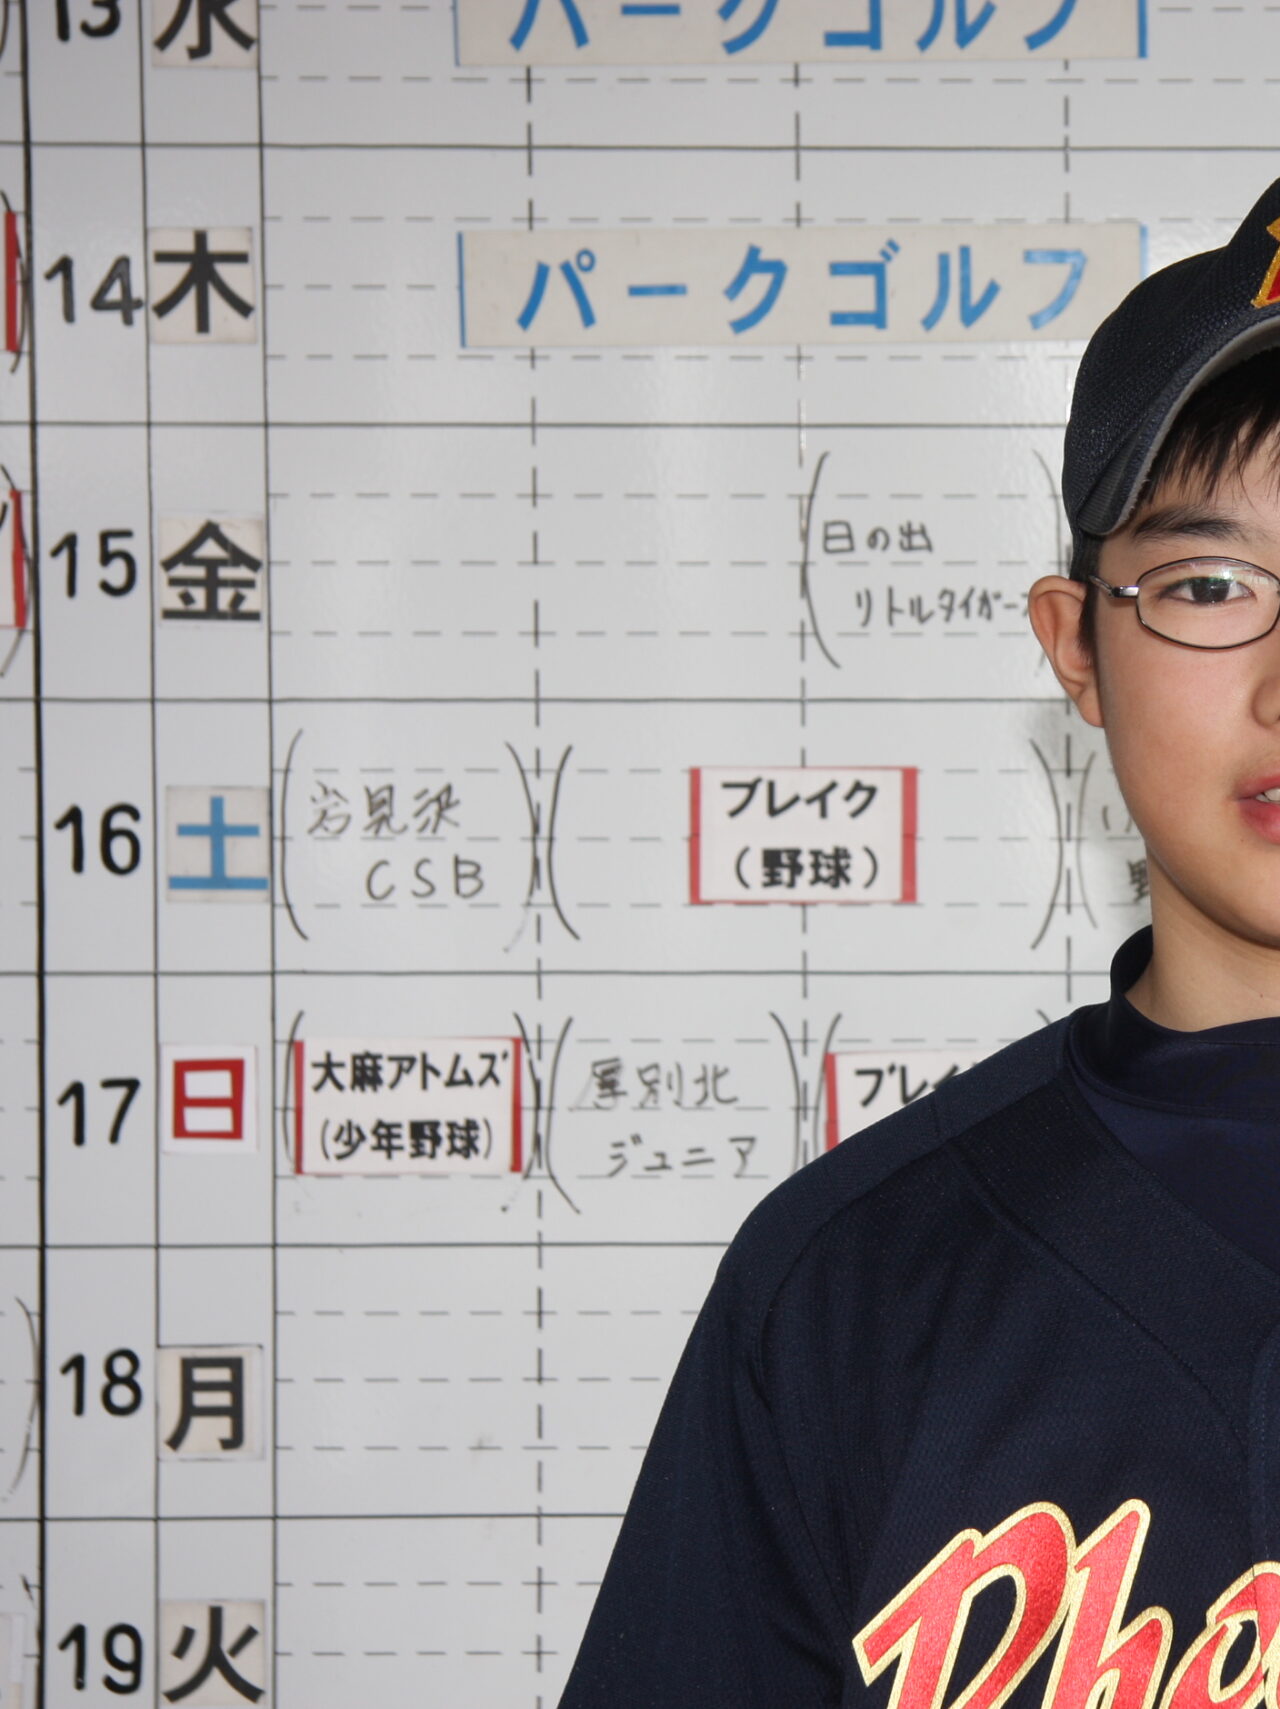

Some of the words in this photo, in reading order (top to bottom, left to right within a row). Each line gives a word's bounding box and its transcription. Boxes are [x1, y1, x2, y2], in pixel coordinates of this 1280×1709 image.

[43, 254, 144, 326] 14
[151, 230, 254, 334] 木
[516, 238, 1088, 335] パークゴルフ
[50, 529, 138, 598] 15
[160, 520, 263, 621] 金
[822, 520, 934, 555] 日の出
[855, 584, 1028, 628] リトルタイガー
[721, 778, 879, 818] ブレイク
[54, 803, 142, 875] 16
[167, 795, 269, 890] 土
[734, 847, 881, 889] （野球）
[366, 854, 485, 901] CSB
[173, 1058, 245, 1140] 日
[311, 1050, 510, 1093] 大麻アトムズ
[854, 1062, 979, 1109] ブレ
[57, 1077, 141, 1147] 17
[320, 1116, 493, 1161] (少年野球)
[59, 1347, 143, 1417] 18
[165, 1356, 245, 1452] 月
[57, 1623, 143, 1695] 19
[162, 1605, 266, 1704] 火
